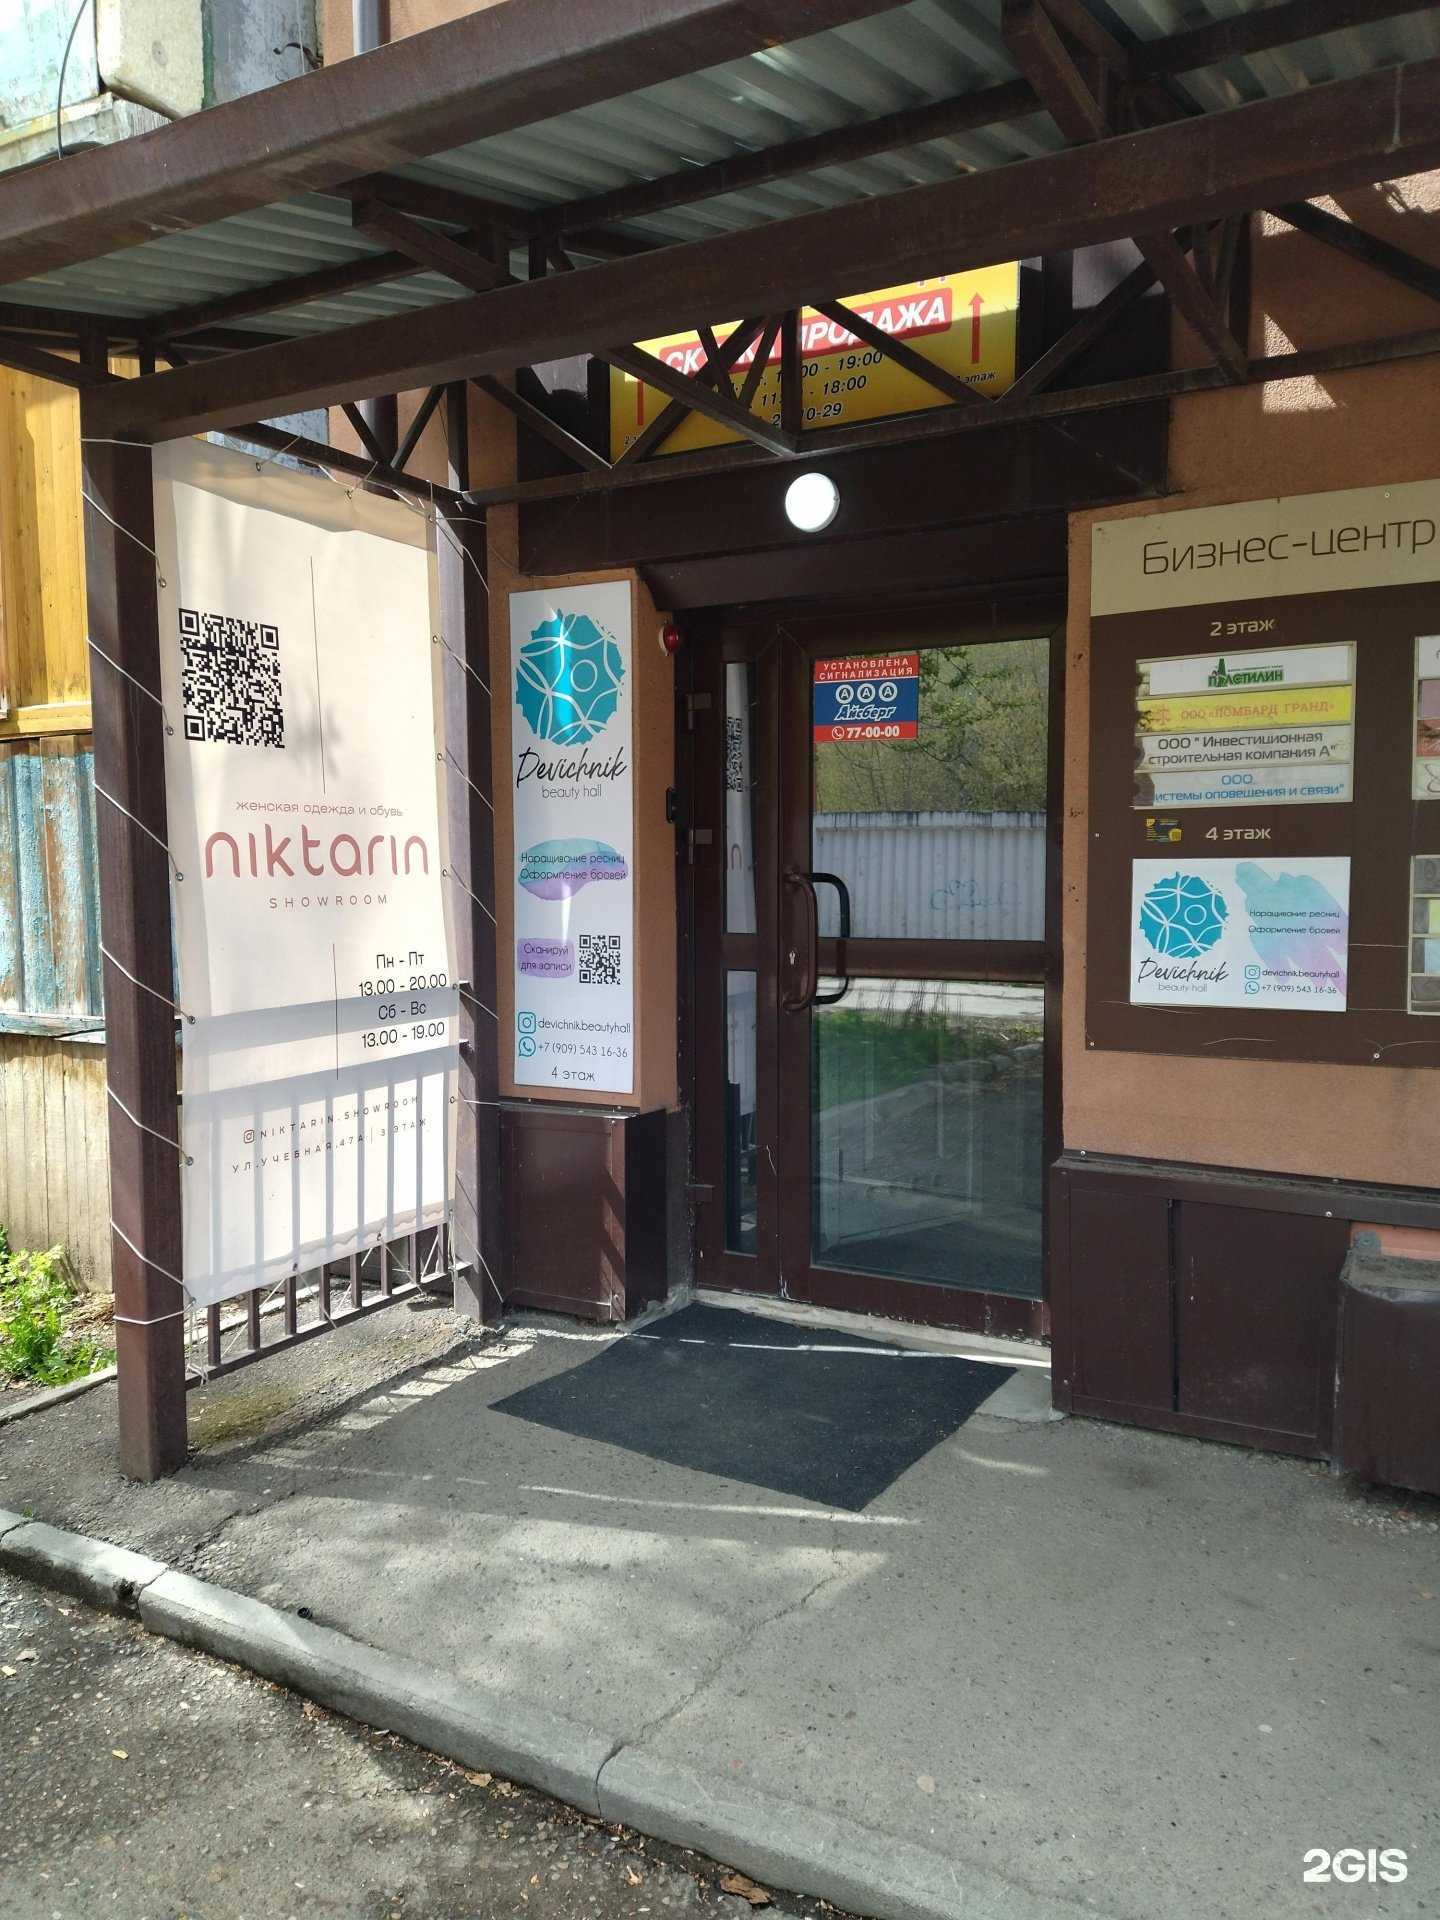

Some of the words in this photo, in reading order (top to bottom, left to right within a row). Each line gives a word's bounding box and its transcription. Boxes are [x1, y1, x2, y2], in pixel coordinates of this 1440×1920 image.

[838, 352, 883, 371] 19:00
[823, 376, 867, 395] 18:00
[1143, 518, 1436, 575] Бизнес-центр
[1210, 621, 1222, 636] 2
[1227, 618, 1275, 635] этаж
[823, 658, 909, 671] УСТАНОВЛЕНА
[819, 667, 913, 680] СИГНАЛИЗАЦИЯ
[834, 704, 897, 722] Айсберг
[846, 725, 900, 738] 77-00-00
[1158, 737, 1191, 750] ООО
[1148, 750, 1242, 767] строительная
[1245, 748, 1316, 760] компания
[516, 746, 628, 789] Devichnik
[1221, 774, 1253, 785] ООО
[541, 785, 580, 800] beauty
[583, 784, 602, 798] hall
[1155, 791, 1202, 802] истемы
[1205, 786, 1286, 801] оповещения
[1289, 787, 1297, 796] и
[236, 800, 299, 813] женская
[303, 804, 355, 816] одежда
[358, 807, 366, 816] и
[369, 805, 403, 818] обувь
[1205, 826, 1218, 840] 4
[1223, 826, 1272, 841] этаж
[205, 823, 429, 878] niktarin
[521, 852, 587, 865] Наращивание
[589, 855, 625, 865] ресниц
[520, 868, 587, 881] Оформление
[590, 868, 626, 880] бровей
[269, 894, 388, 909] SHOWROOM
[523, 943, 569, 957] Сканируй
[376, 953, 394, 969] Пн
[408, 951, 425, 967] Пт
[520, 962, 537, 972] для
[538, 962, 572, 972] записи
[1137, 956, 1229, 984] Devichnik
[358, 979, 395, 997] 13.00
[409, 973, 447, 991] 20.00
[1158, 982, 1190, 994] beauty
[1191, 983, 1208, 993] hall
[378, 1003, 397, 1020] Сб
[410, 1001, 427, 1016] Вс
[538, 1018, 631, 1034] devichnik.beautyhall
[361, 1029, 398, 1048] 13.00
[412, 1021, 445, 1040] 19.00
[538, 1042, 550, 1052] +7
[552, 1042, 577, 1055] (909)
[579, 1044, 598, 1056] 543
[600, 1045, 628, 1058] 16-36
[551, 1065, 558, 1079] 4
[562, 1069, 596, 1081] этаж
